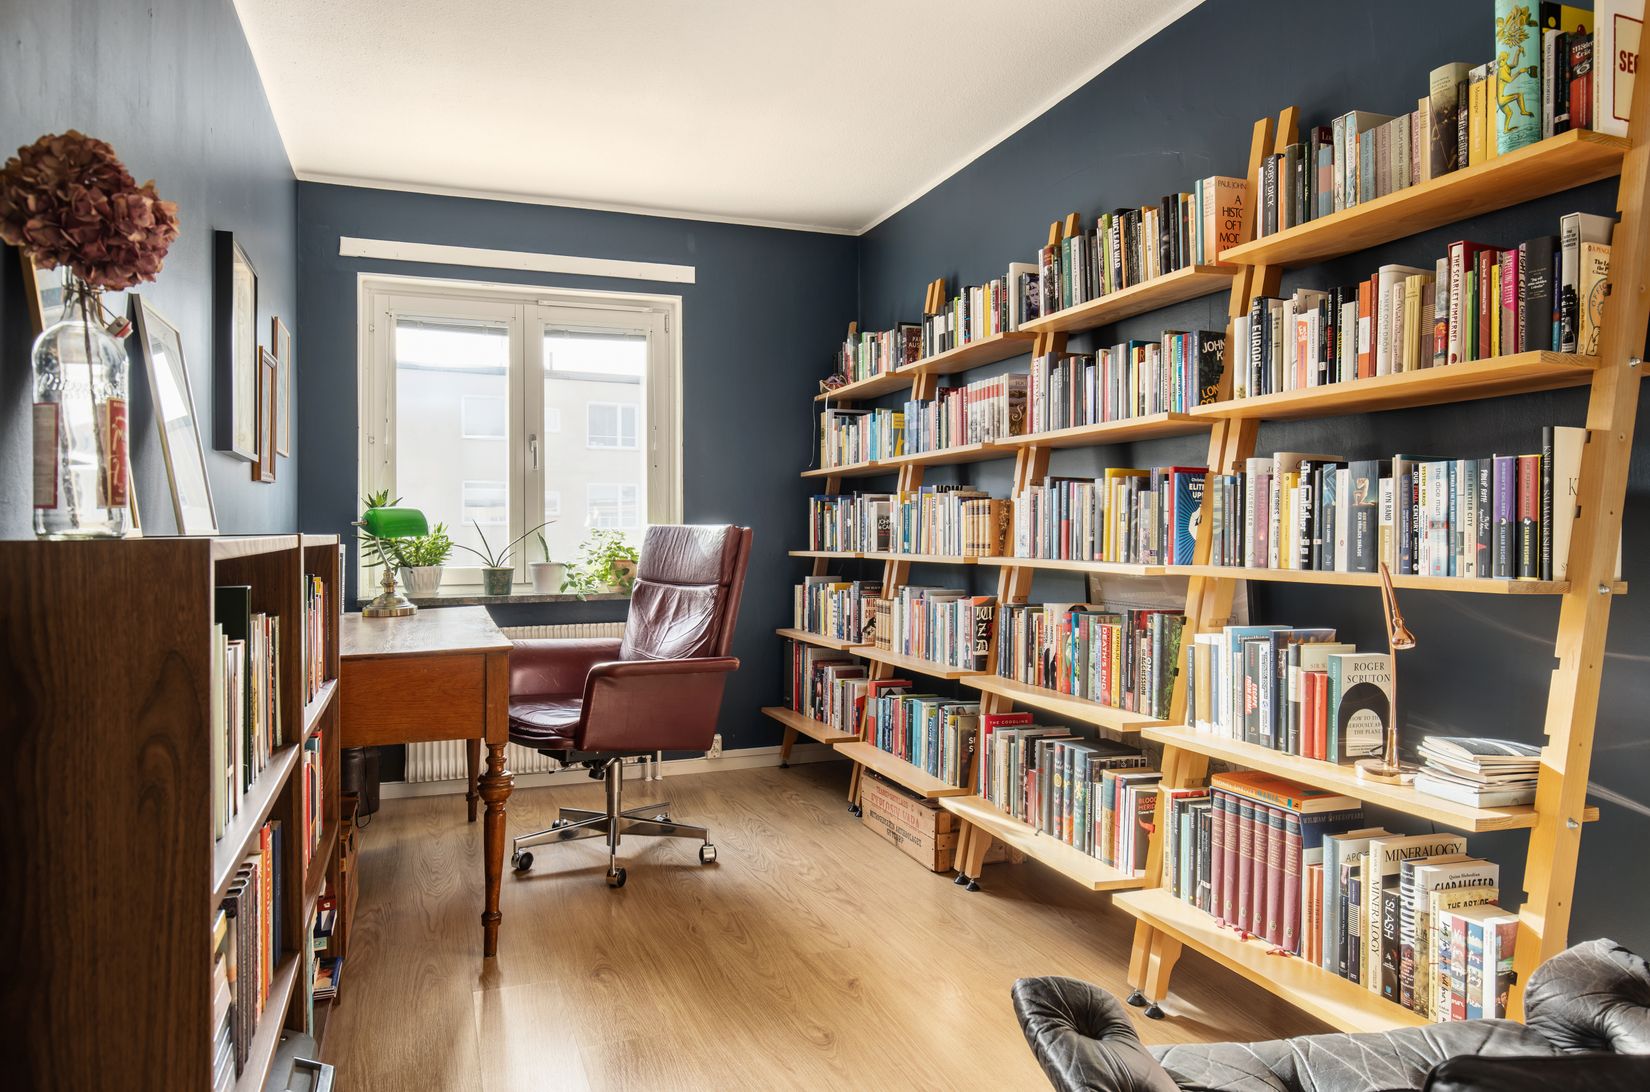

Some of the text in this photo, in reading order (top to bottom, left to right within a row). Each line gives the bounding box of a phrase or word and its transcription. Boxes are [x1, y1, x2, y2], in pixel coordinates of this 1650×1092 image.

[1113, 215, 1121, 269] NUCLEAR WAR
[1225, 219, 1236, 230] OF
[1519, 250, 1527, 275] FIGHT
[1452, 254, 1460, 342] THE SCARLET PIMPERNEL
[1504, 285, 1514, 304] BETTER
[1519, 279, 1527, 302] CLUB
[1252, 325, 1262, 368] EUROPE
[1300, 462, 1312, 532] The Godfather
[1480, 469, 1489, 503] PHILIP ROTH
[1543, 445, 1551, 563] KNIFE SALMAN RUSHDIE
[1346, 674, 1391, 684] SCRUTON
[1353, 661, 1385, 671] ROGER
[1385, 842, 1462, 863] MINERALOGY
[1371, 879, 1381, 956] MINERALOGY
[1383, 898, 1395, 940] SLASH
[1400, 881, 1415, 944] DRUNK
